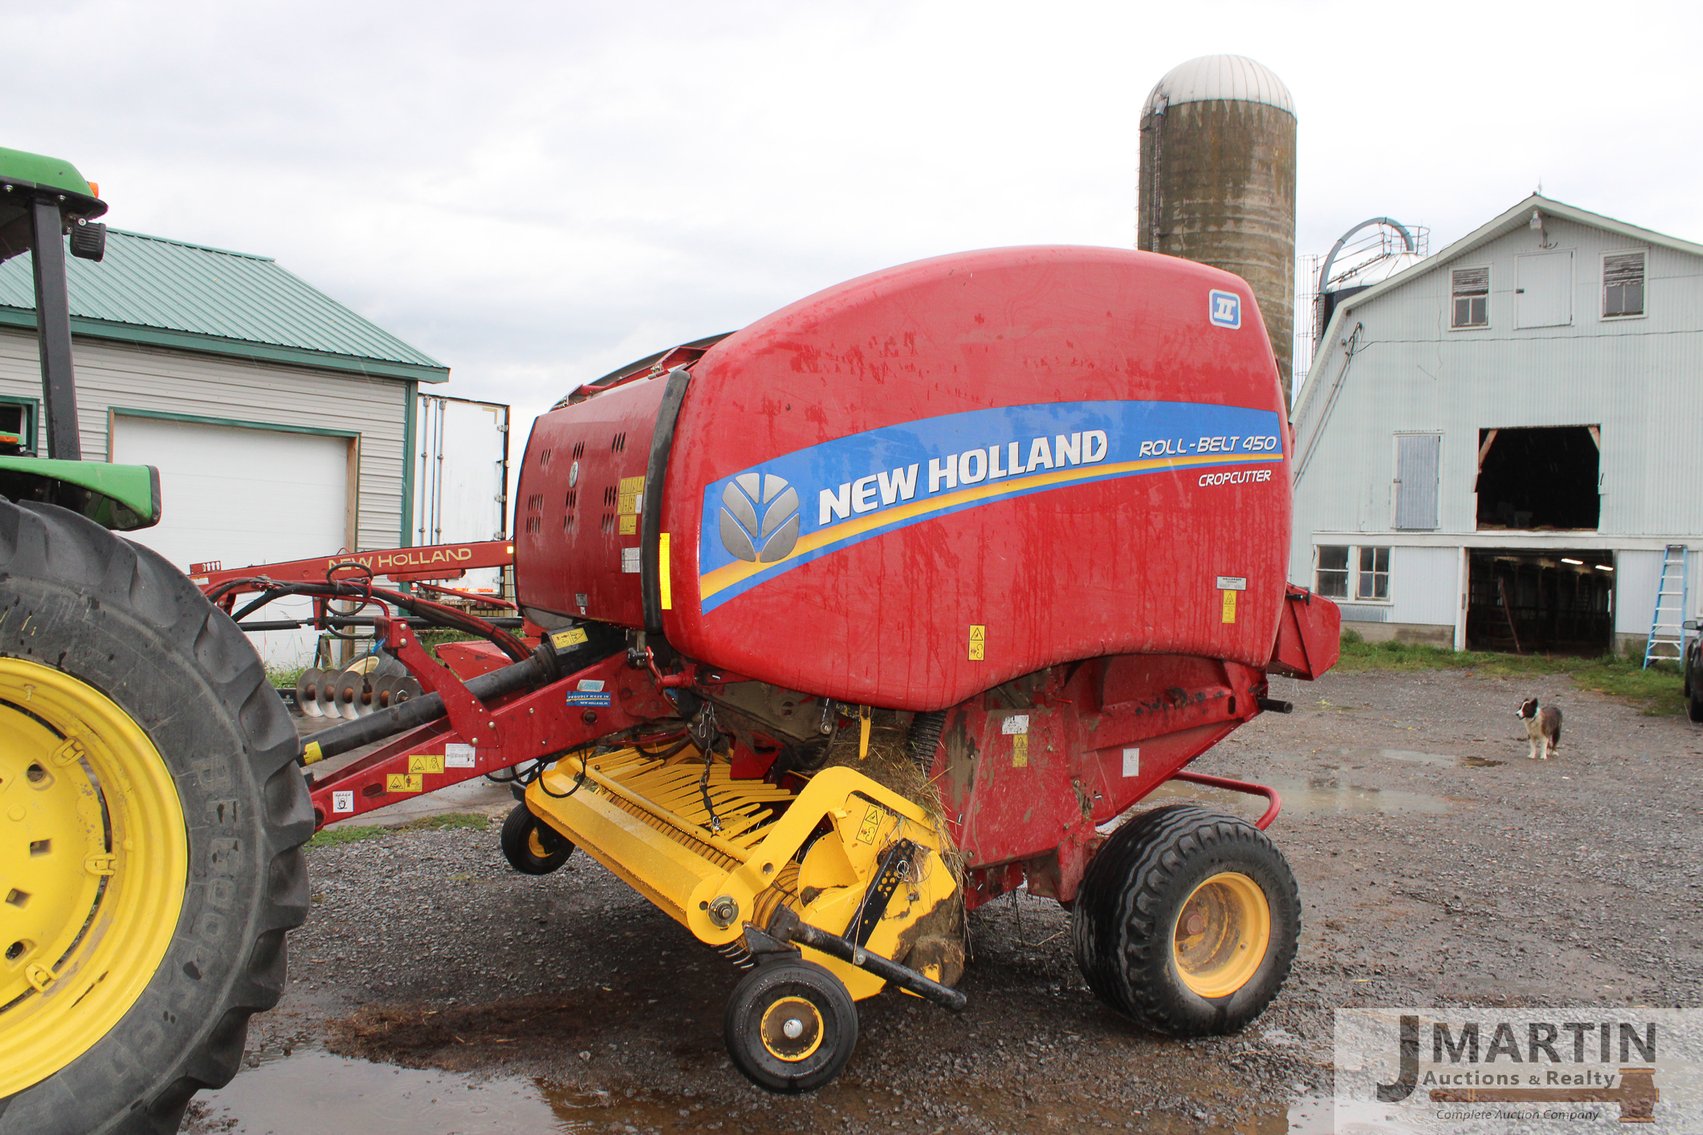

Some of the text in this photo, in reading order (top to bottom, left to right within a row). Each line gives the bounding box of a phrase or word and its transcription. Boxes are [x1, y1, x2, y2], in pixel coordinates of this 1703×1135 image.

[1242, 435, 1278, 452] 450
[818, 430, 1109, 526] NEW HOLLAND
[1197, 469, 1272, 487] CROPCUTTER
[328, 547, 472, 571] NEW HOLLAND
